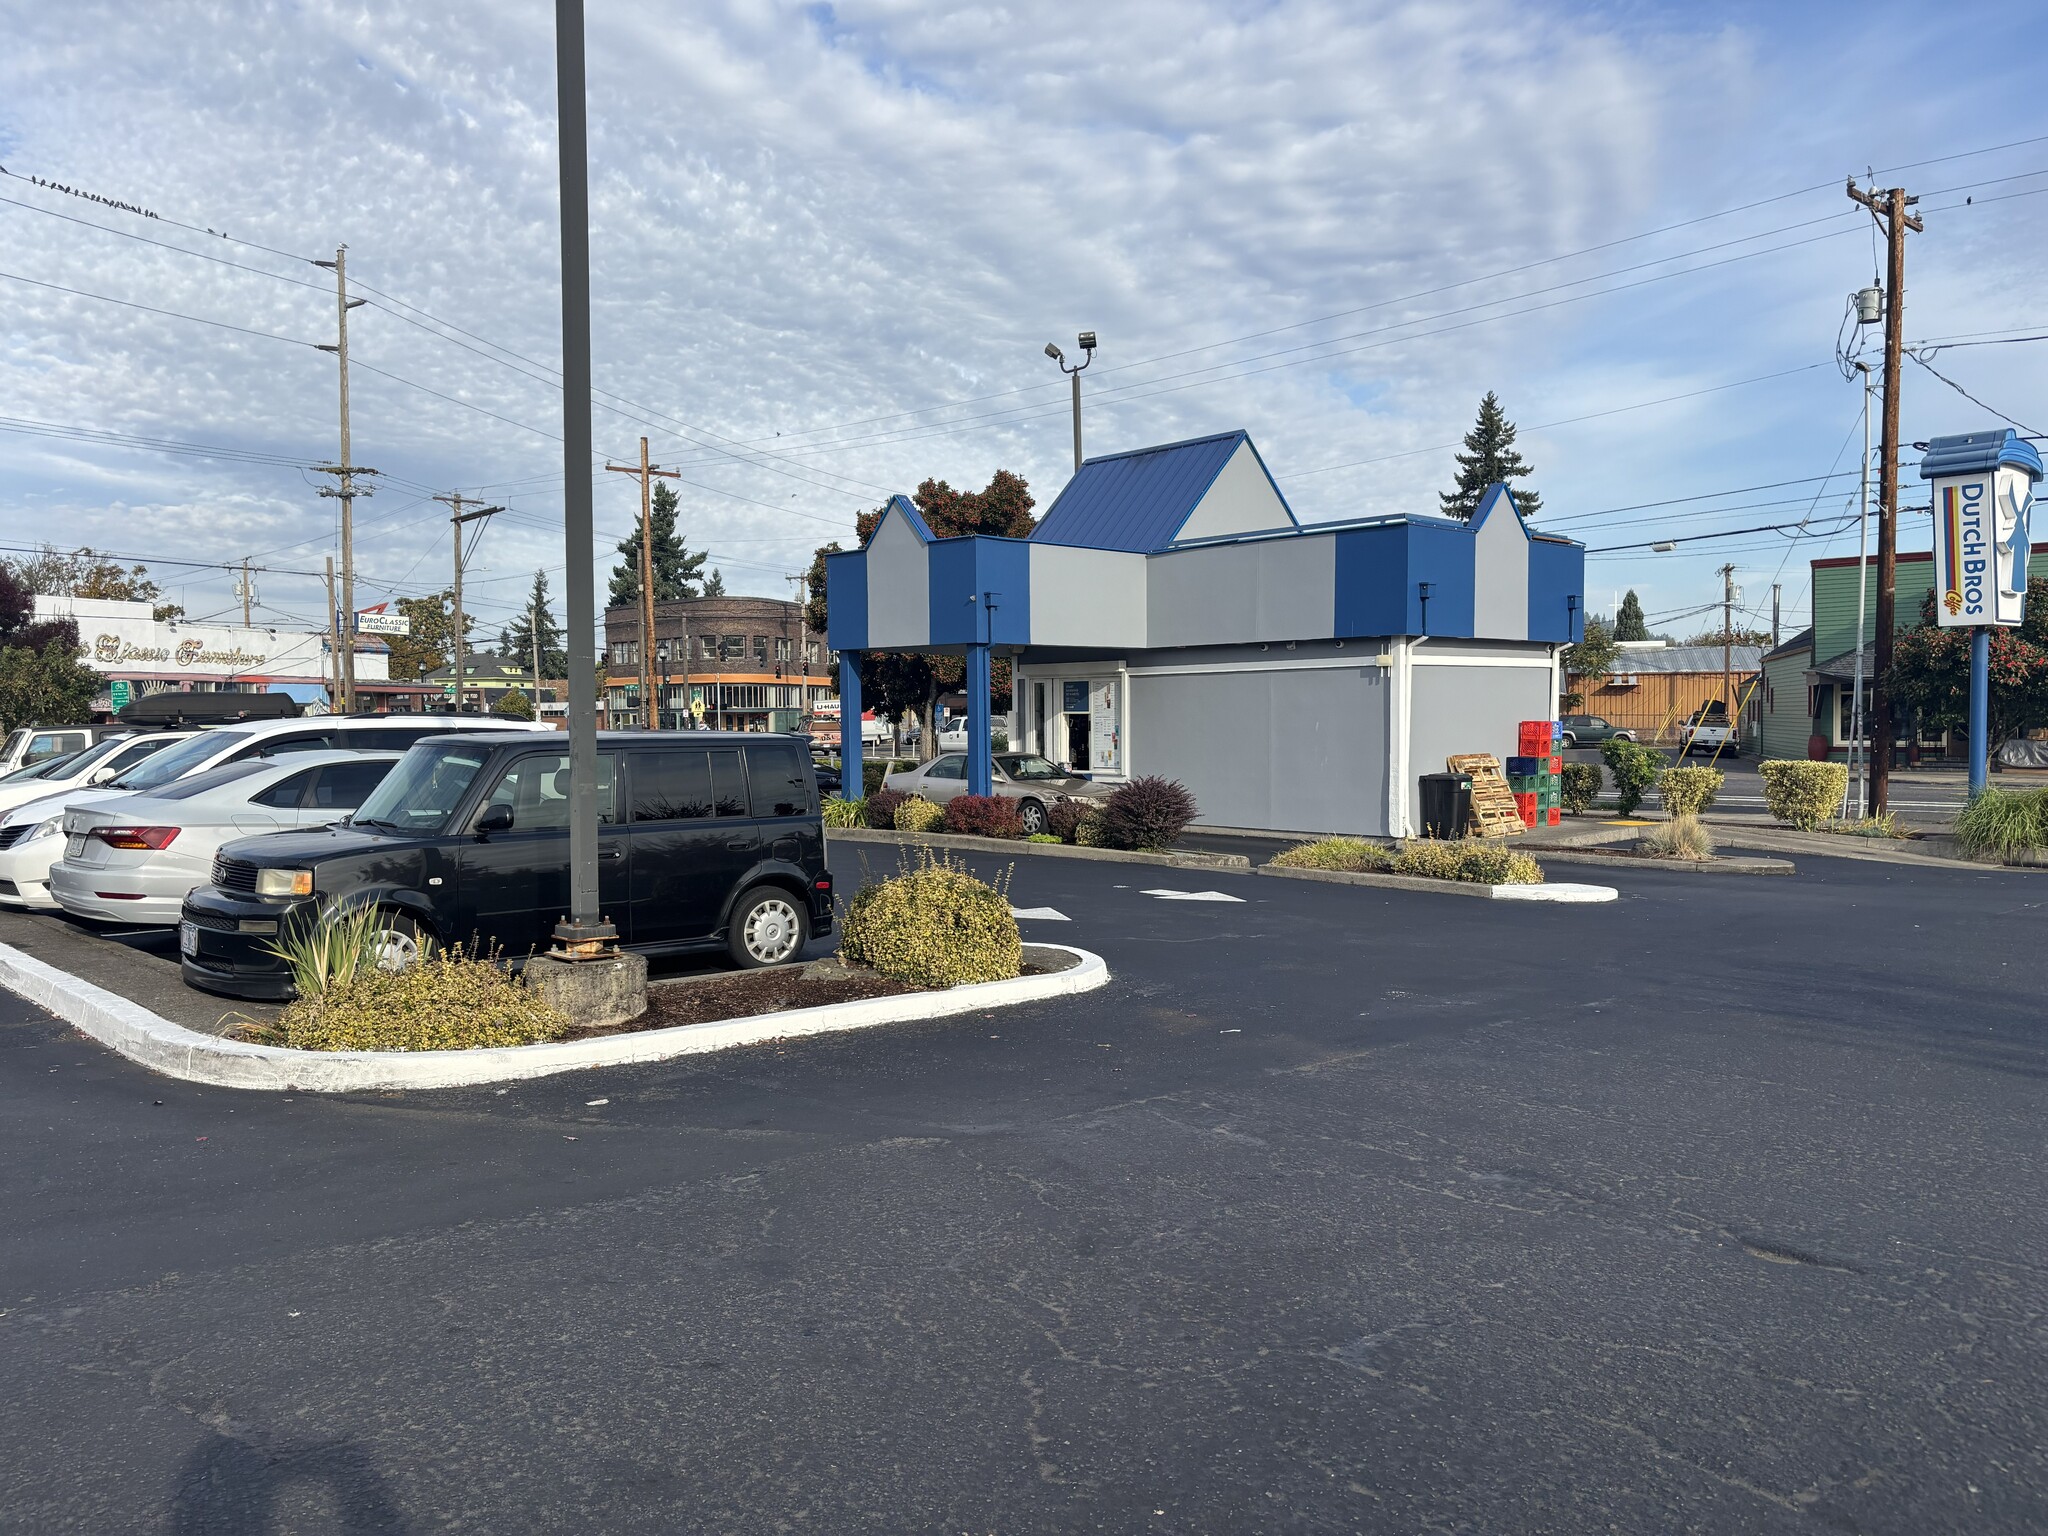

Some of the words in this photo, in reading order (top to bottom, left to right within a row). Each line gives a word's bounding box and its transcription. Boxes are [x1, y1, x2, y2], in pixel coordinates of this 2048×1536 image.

[1961, 483, 1986, 556] DUTCH
[1943, 590, 1963, 617] Coffee
[1963, 559, 1986, 616] BROS
[367, 623, 402, 632] FURNITURE
[94, 633, 170, 664] Classic
[175, 638, 266, 667] Furniture
